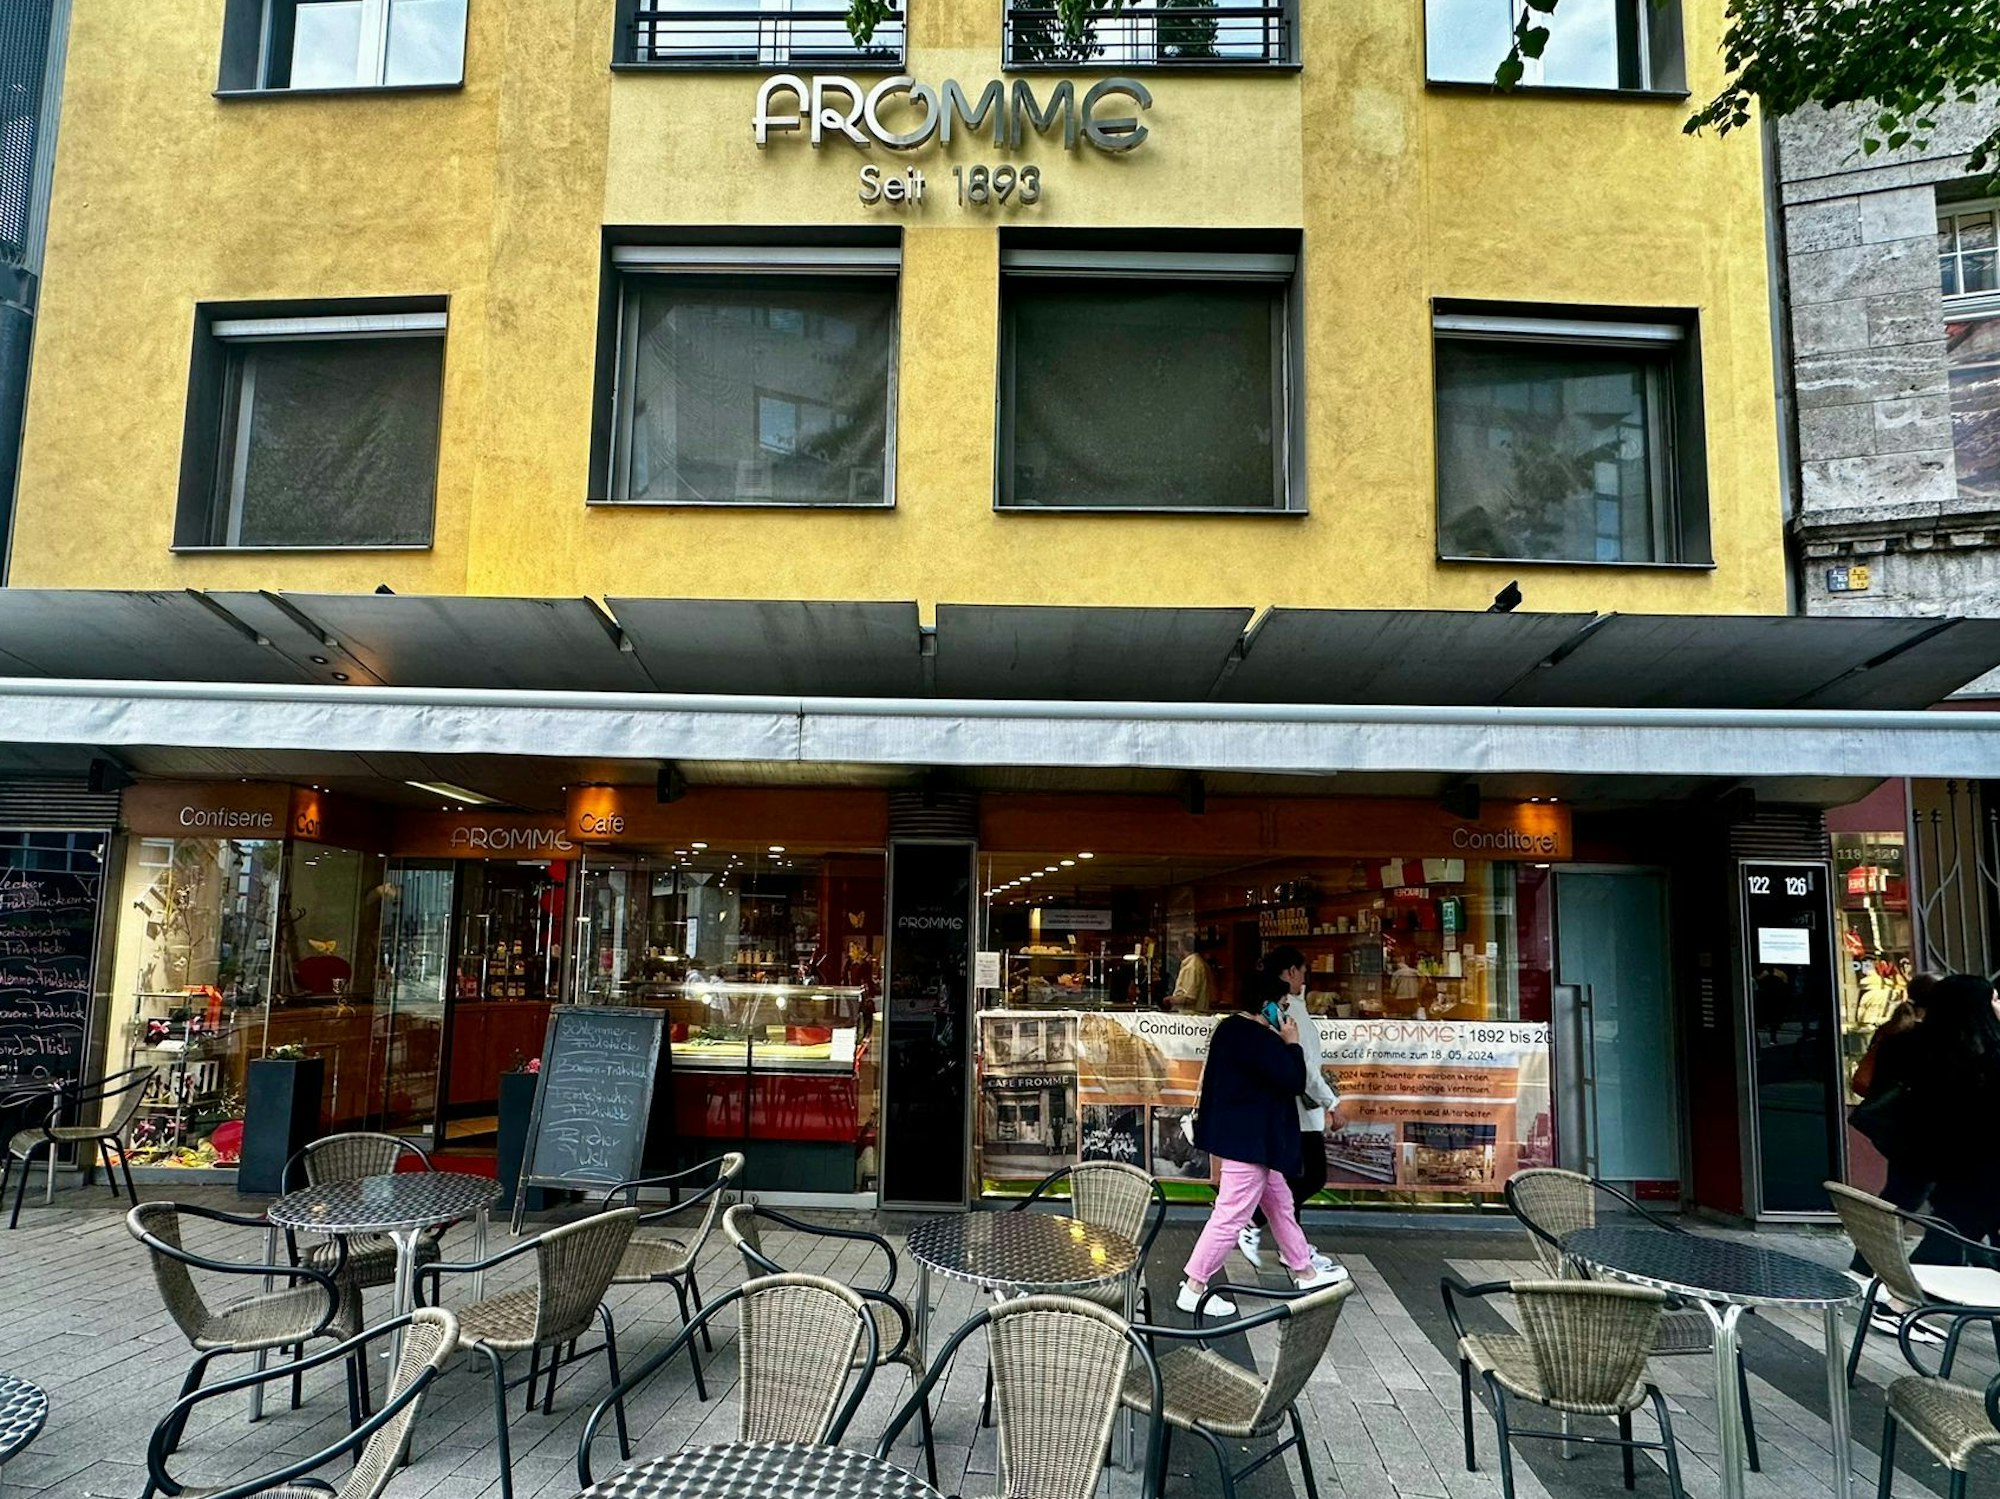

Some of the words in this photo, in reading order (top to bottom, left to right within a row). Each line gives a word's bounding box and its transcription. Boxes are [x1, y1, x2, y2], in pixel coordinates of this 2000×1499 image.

[752, 73, 1153, 152] FROMME
[858, 164, 926, 206] Seit
[951, 164, 1042, 207] 1893
[179, 806, 274, 828] Confiserie
[578, 811, 625, 835] Cafe
[1452, 828, 1559, 853] Conditorei
[1838, 849, 1862, 860] 118
[1748, 876, 1771, 894] 122
[1785, 877, 1807, 896] 126
[1139, 1020, 1212, 1037] Conditorei
[1320, 1027, 1347, 1041] erie
[1469, 1029, 1505, 1043] 1892
[1510, 1030, 1531, 1043] bis
[1321, 1049, 1338, 1059] das
[1342, 1048, 1365, 1059] Café
[1367, 1049, 1407, 1059] Fromme
[1410, 1052, 1428, 1060] zum
[1018, 1076, 1070, 1087] FROMME
[1381, 1070, 1416, 1079] Inventar
[1384, 1083, 1397, 1091] das
[1424, 1109, 1440, 1117] und
